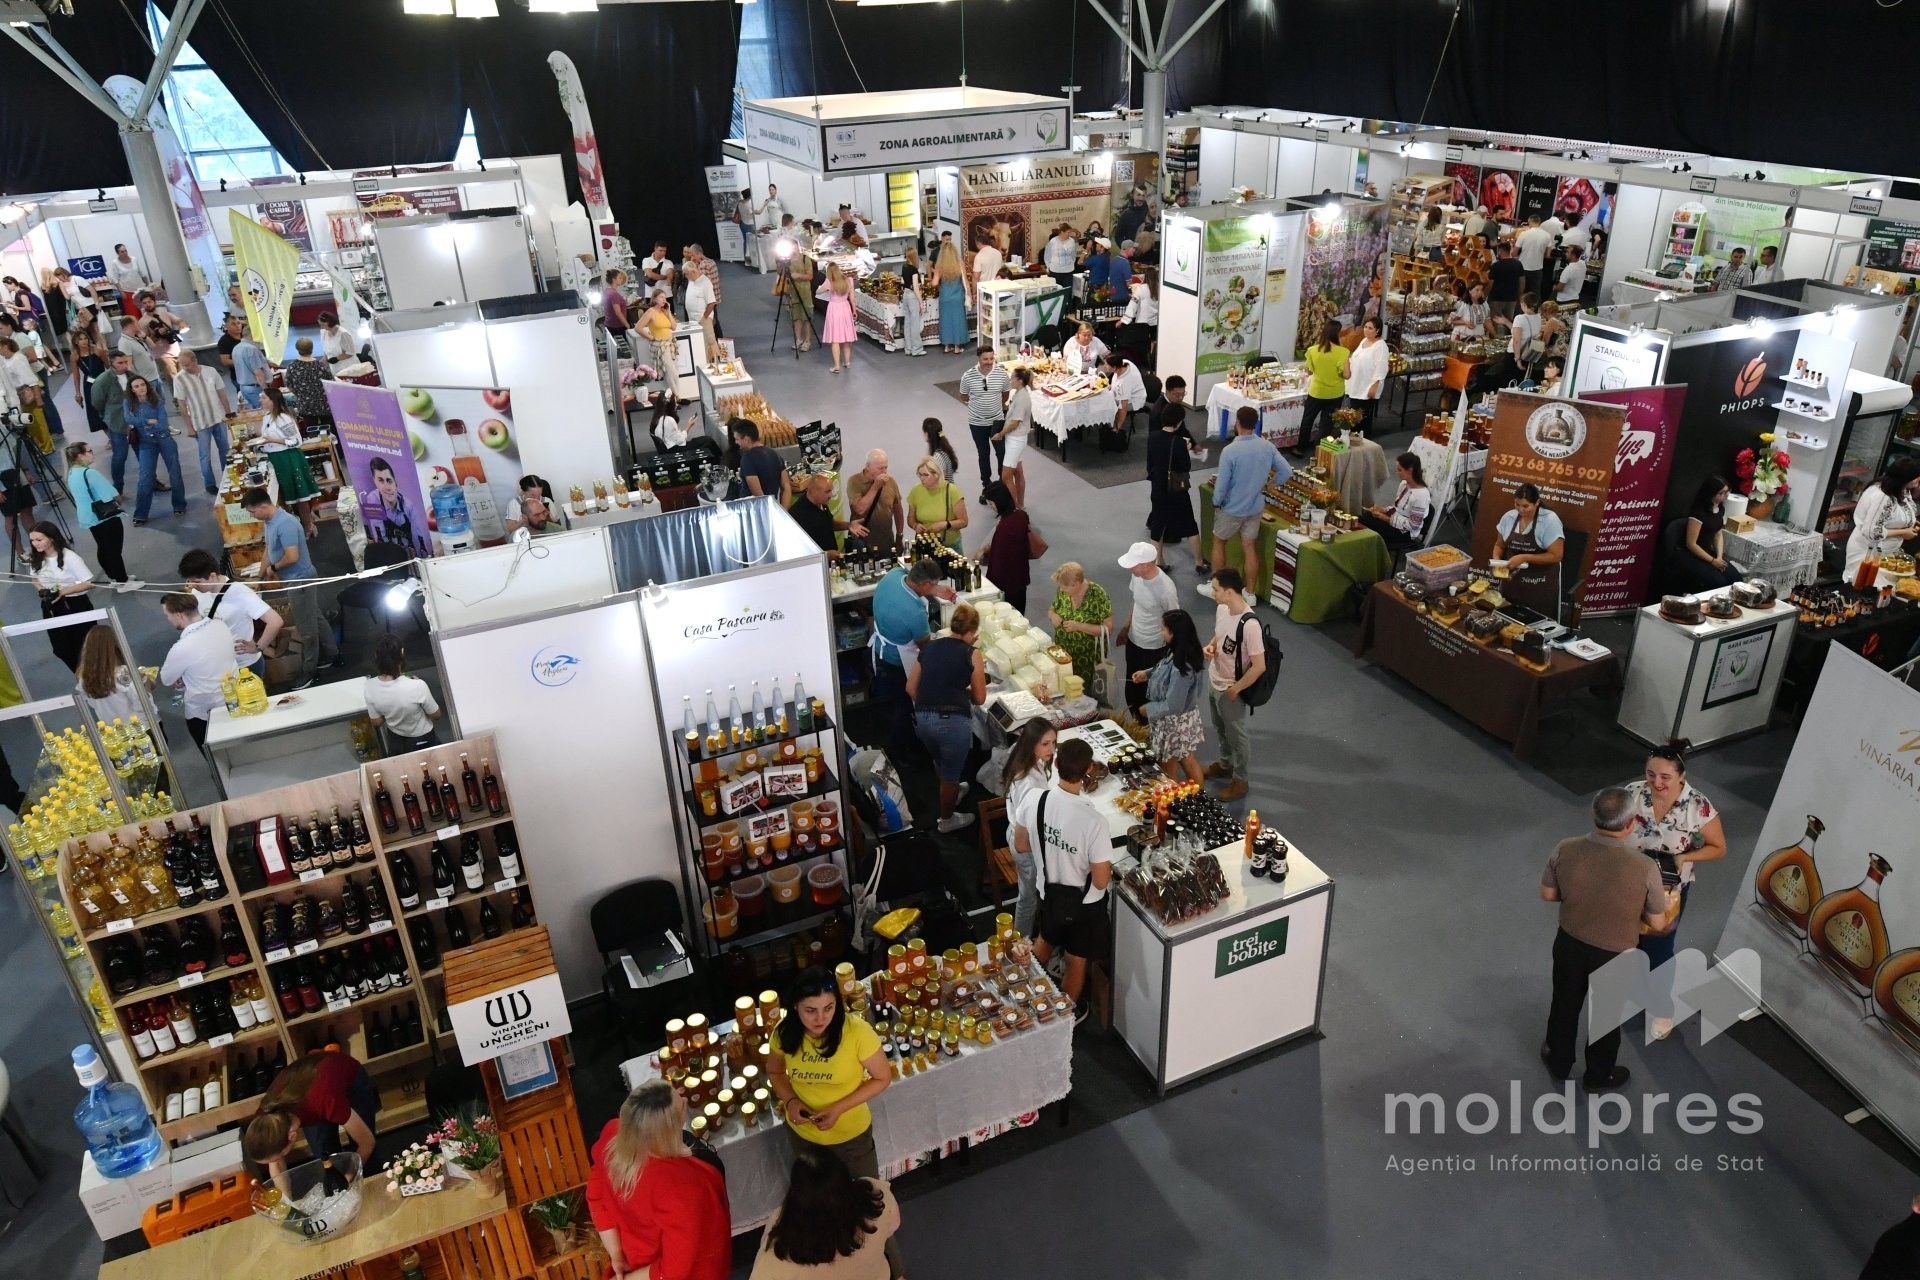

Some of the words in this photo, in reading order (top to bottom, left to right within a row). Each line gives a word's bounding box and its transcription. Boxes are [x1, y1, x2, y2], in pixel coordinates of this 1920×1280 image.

[879, 138, 909, 150] ZONA
[911, 128, 1004, 147] AGROALIMENTARĂ
[968, 170, 1017, 186] HANUL
[1746, 200, 1778, 213] Moldovei
[1853, 204, 1877, 212] FLORADO
[1720, 397, 1765, 414] PHIOPS
[1490, 453, 1524, 468] +373
[1526, 458, 1545, 472] 68
[1548, 462, 1575, 477] 765
[1577, 466, 1607, 481] 907
[1492, 476, 1510, 486] Babă
[1542, 486, 1570, 496] Mariana
[1571, 490, 1598, 501] Zabrian
[1568, 497, 1585, 507] Nord
[1614, 498, 1660, 510] Patiserie
[1616, 524, 1653, 534] proaspete
[1604, 566, 1622, 575] Bar
[1583, 591, 1629, 602] 060351001
[684, 623, 713, 638] Casa
[717, 612, 767, 631] Pascaru
[1232, 931, 1259, 953] trei
[1227, 939, 1278, 966] bobițe
[480, 1020, 550, 1049] UNGHENI
[491, 1019, 535, 1037] VINARIA
[791, 1068, 833, 1080] Pascaru
[328, 1259, 357, 1274] WINE
